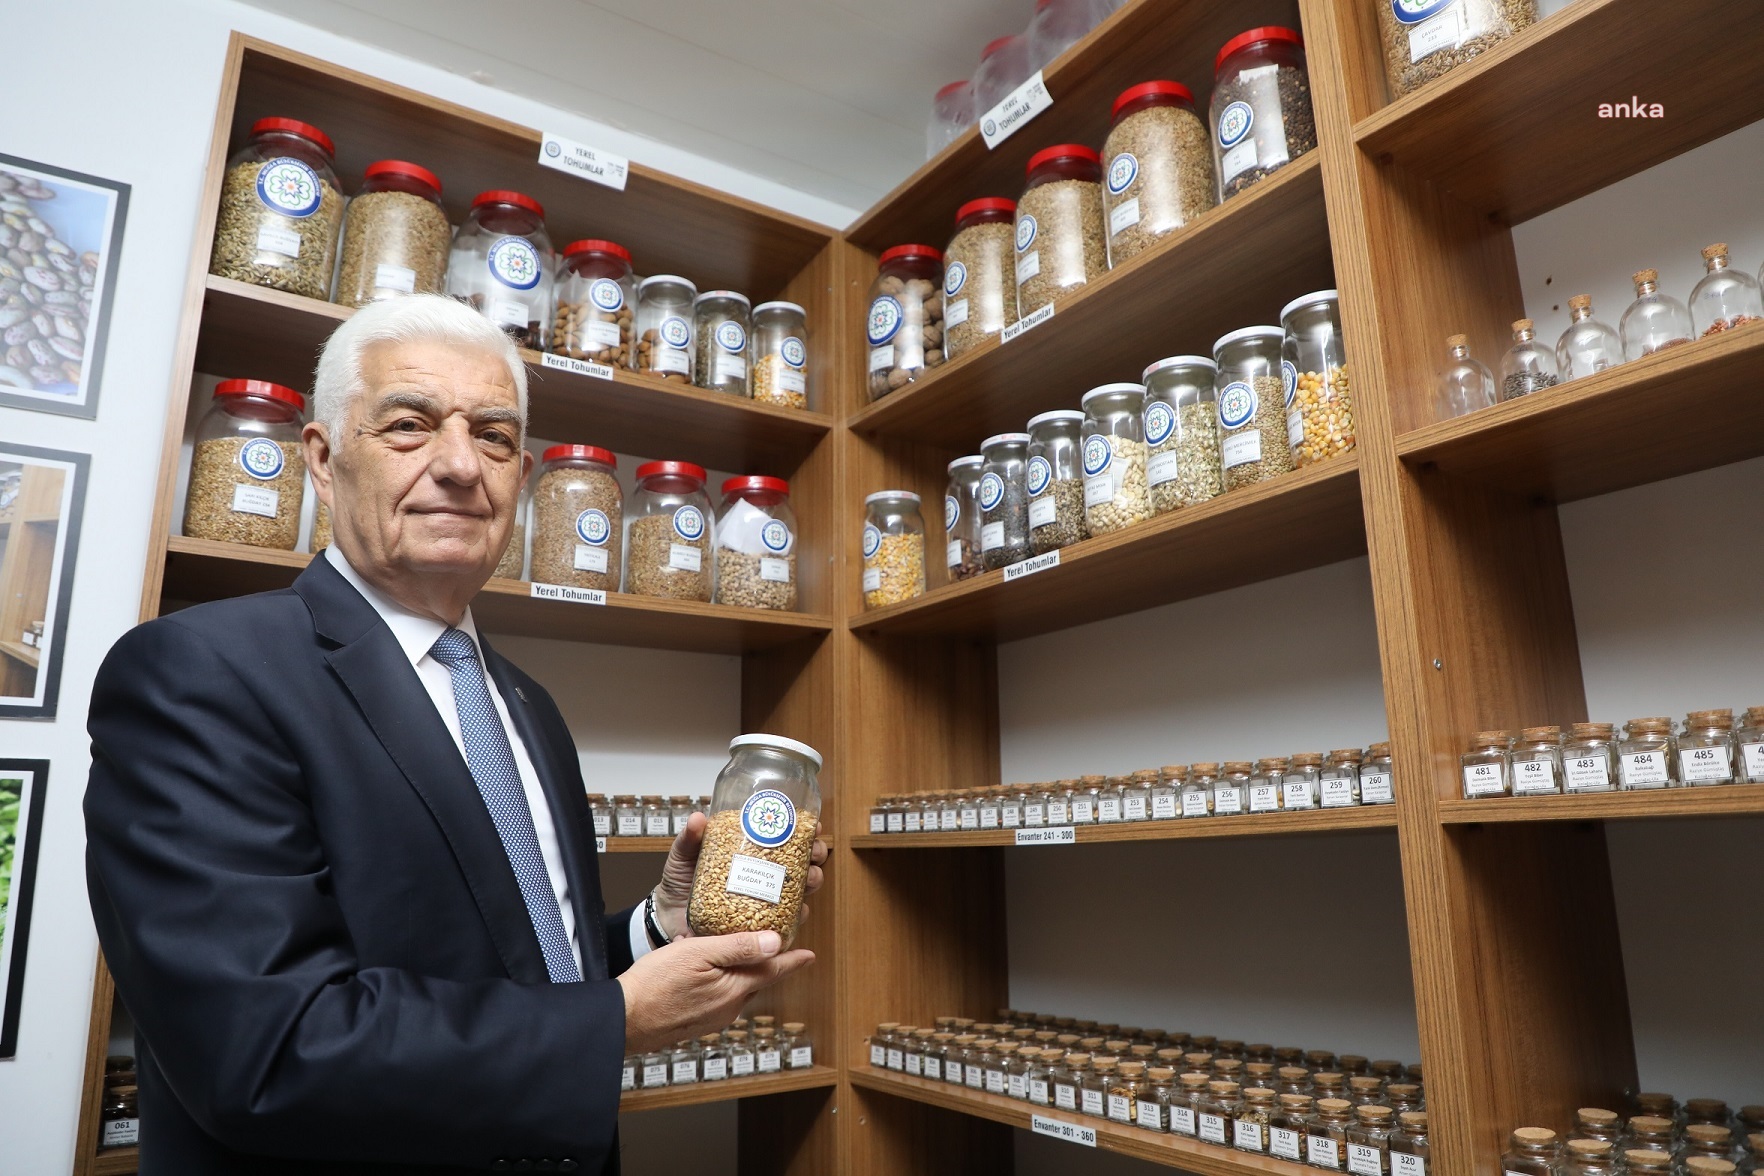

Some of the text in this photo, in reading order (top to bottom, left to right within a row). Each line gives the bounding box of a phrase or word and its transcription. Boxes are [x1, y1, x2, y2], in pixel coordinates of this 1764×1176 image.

[998, 102, 1032, 130] TOHUMLAR
[563, 156, 604, 176] TOHUMLAR
[1004, 308, 1052, 340] Yerel Tohumlar
[546, 355, 611, 377] Yerel Tohumlar
[1006, 554, 1057, 578] Yerel Tohumlar
[535, 585, 602, 602] Yerel Tohumlar
[1634, 754, 1653, 764] 484
[1694, 750, 1714, 760] 485
[1525, 763, 1541, 771] 482
[1577, 759, 1595, 768] 483
[1475, 767, 1491, 775] 481
[1369, 776, 1382, 784] 260
[1291, 784, 1303, 792] 258
[1017, 832, 1042, 841] Envanter
[1043, 831, 1055, 840] 241
[1061, 830, 1073, 840] 300
[741, 867, 775, 880] KARAKILÇIK
[737, 874, 762, 885] BUĞDAY
[1144, 1104, 1154, 1112] 313
[1177, 1109, 1188, 1117] 314
[1206, 1116, 1217, 1125] 315
[114, 1121, 130, 1130] 061
[1242, 1124, 1254, 1132] 316
[1034, 1119, 1061, 1134] Envanter
[1062, 1125, 1074, 1137] 301
[1081, 1130, 1094, 1143] 360
[1278, 1131, 1290, 1140] 317
[1316, 1139, 1329, 1148] 318
[1357, 1147, 1372, 1158] 319
[1400, 1156, 1416, 1165] 320
